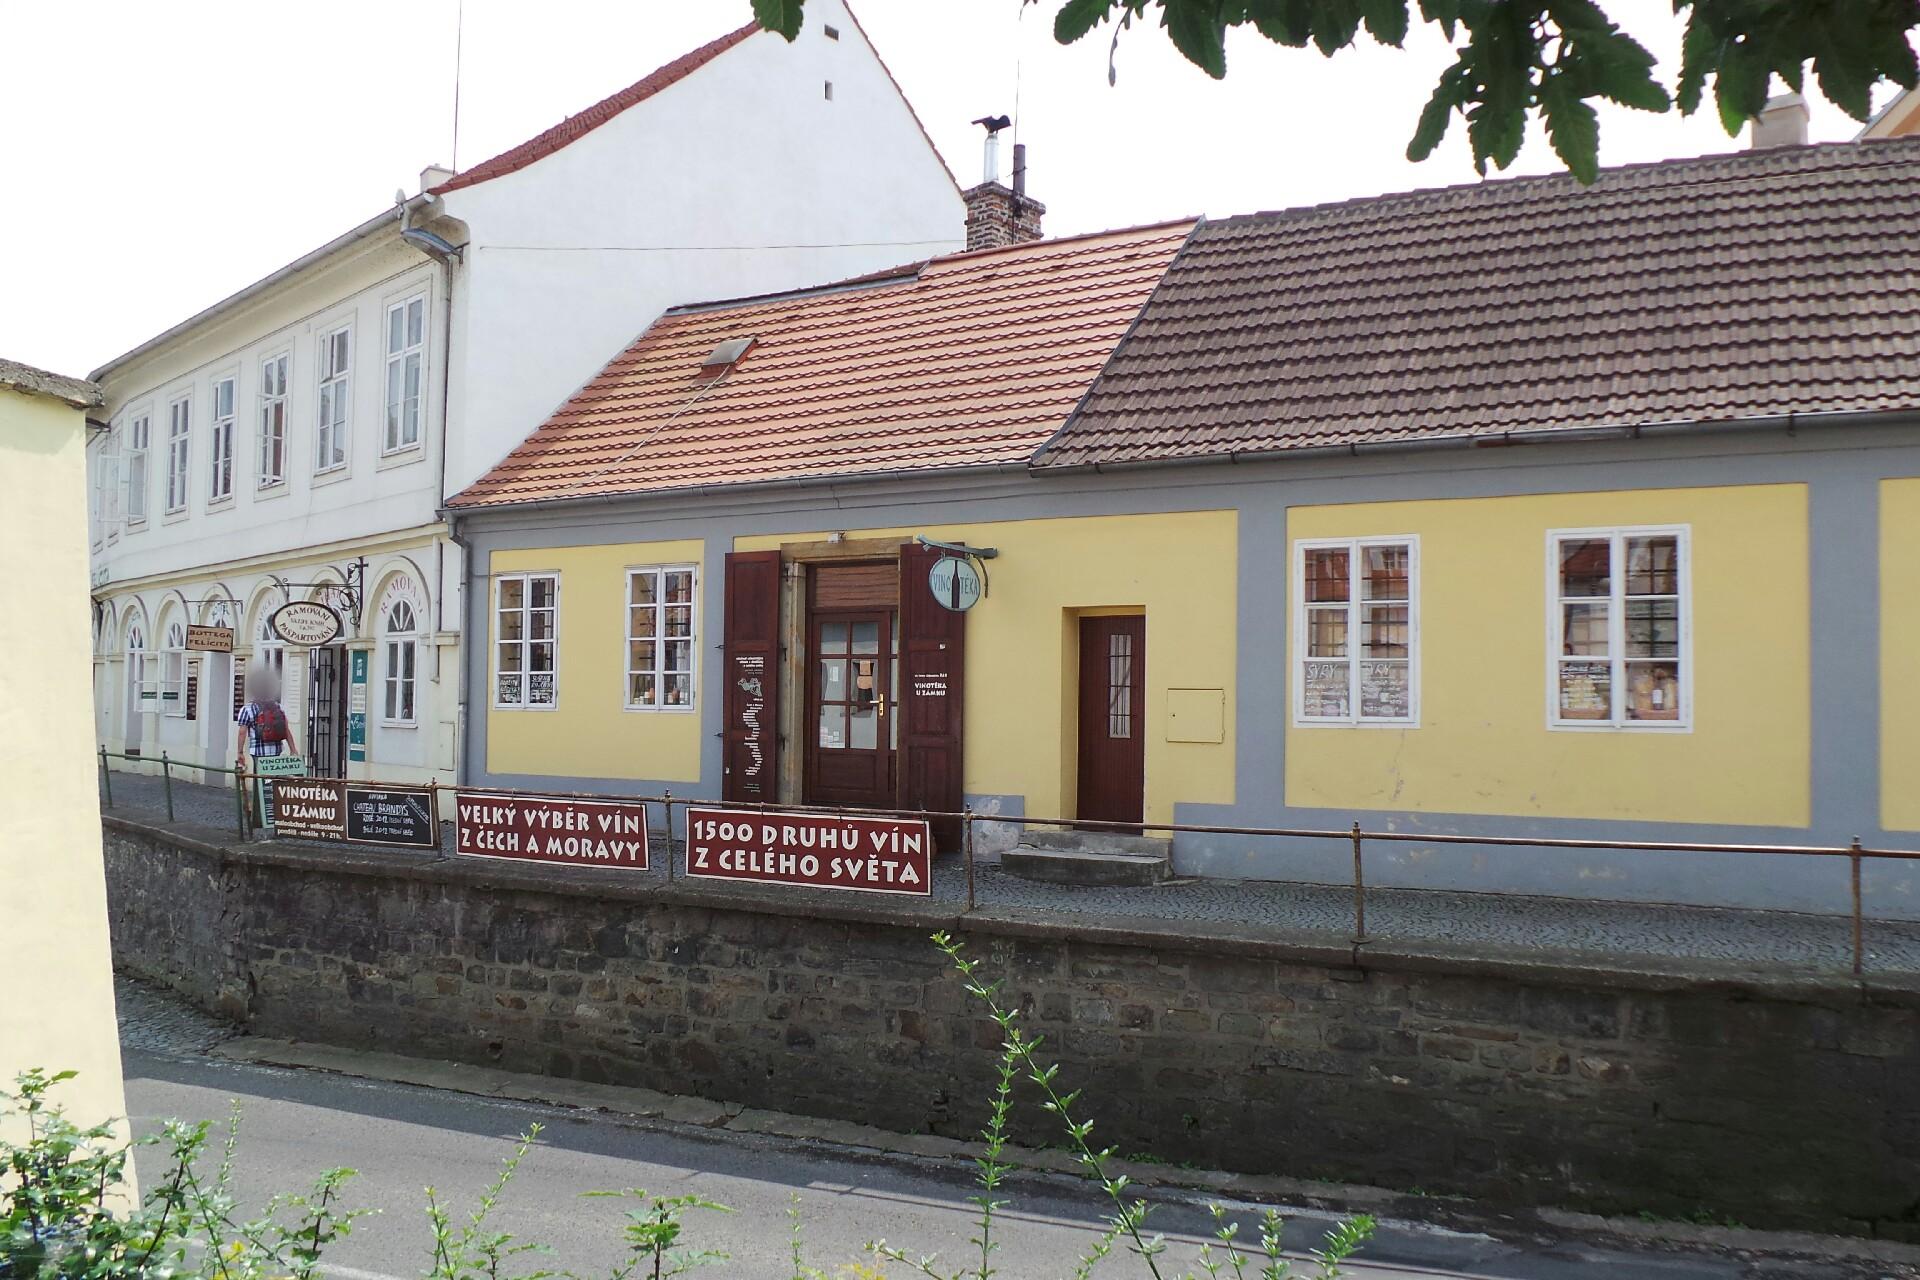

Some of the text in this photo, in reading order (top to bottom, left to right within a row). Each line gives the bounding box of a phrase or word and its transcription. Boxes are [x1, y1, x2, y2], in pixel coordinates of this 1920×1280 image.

[933, 573, 978, 595] VINO TÉKA
[189, 630, 232, 638] BOTTEGA
[278, 785, 339, 802] VINOTÉKA
[282, 803, 336, 820] U ZÁMKU
[460, 803, 639, 834] VELKÝ VÝBĚR VÍN
[461, 825, 641, 861] Z ČECH A MORAVY
[694, 820, 921, 854] 1500 DRUHŮ VÍN
[695, 847, 920, 884] Z CELÉHO SVĚTA
